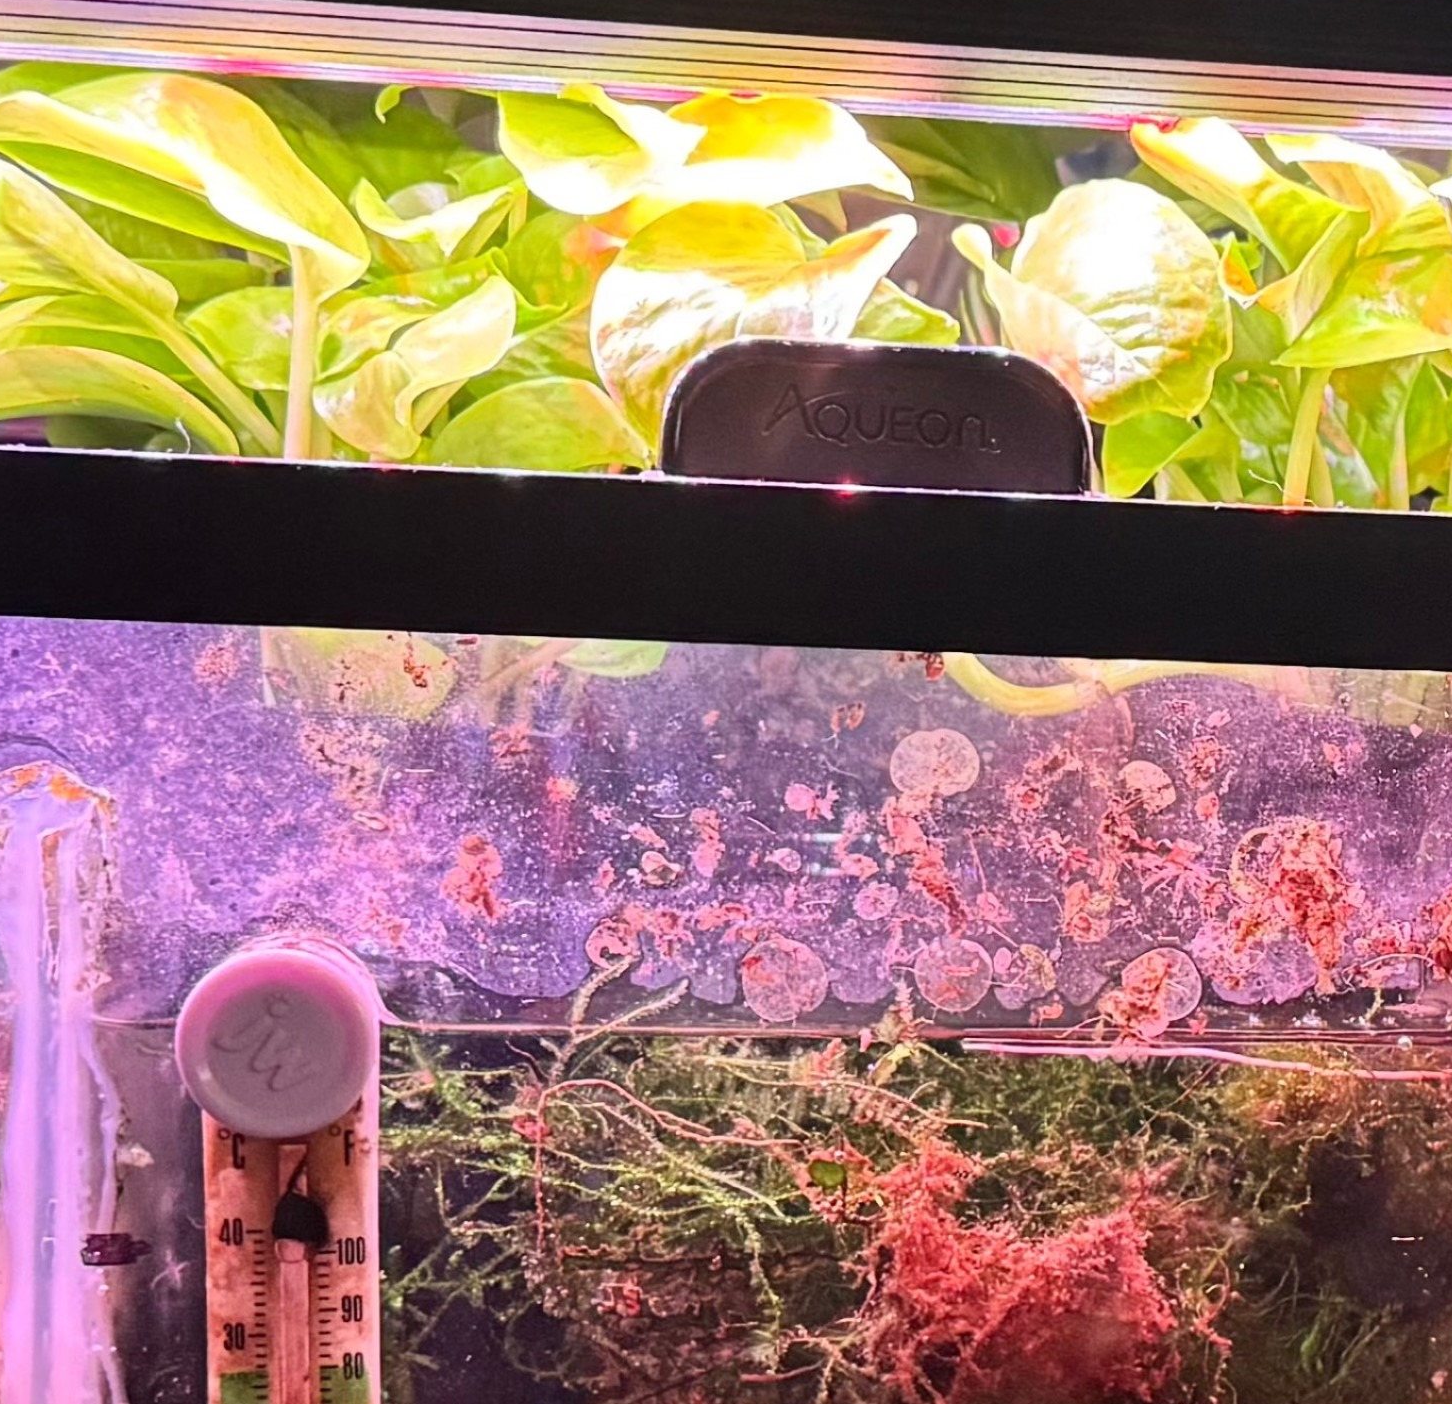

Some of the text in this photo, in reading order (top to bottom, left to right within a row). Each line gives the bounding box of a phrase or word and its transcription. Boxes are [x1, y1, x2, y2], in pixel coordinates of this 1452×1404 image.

[760, 383, 988, 450] AQUEON
[219, 1217, 244, 1247] 40
[336, 1235, 367, 1266] 100
[340, 1293, 365, 1324] 90
[222, 1322, 246, 1351] 30
[343, 1351, 366, 1382] 80
